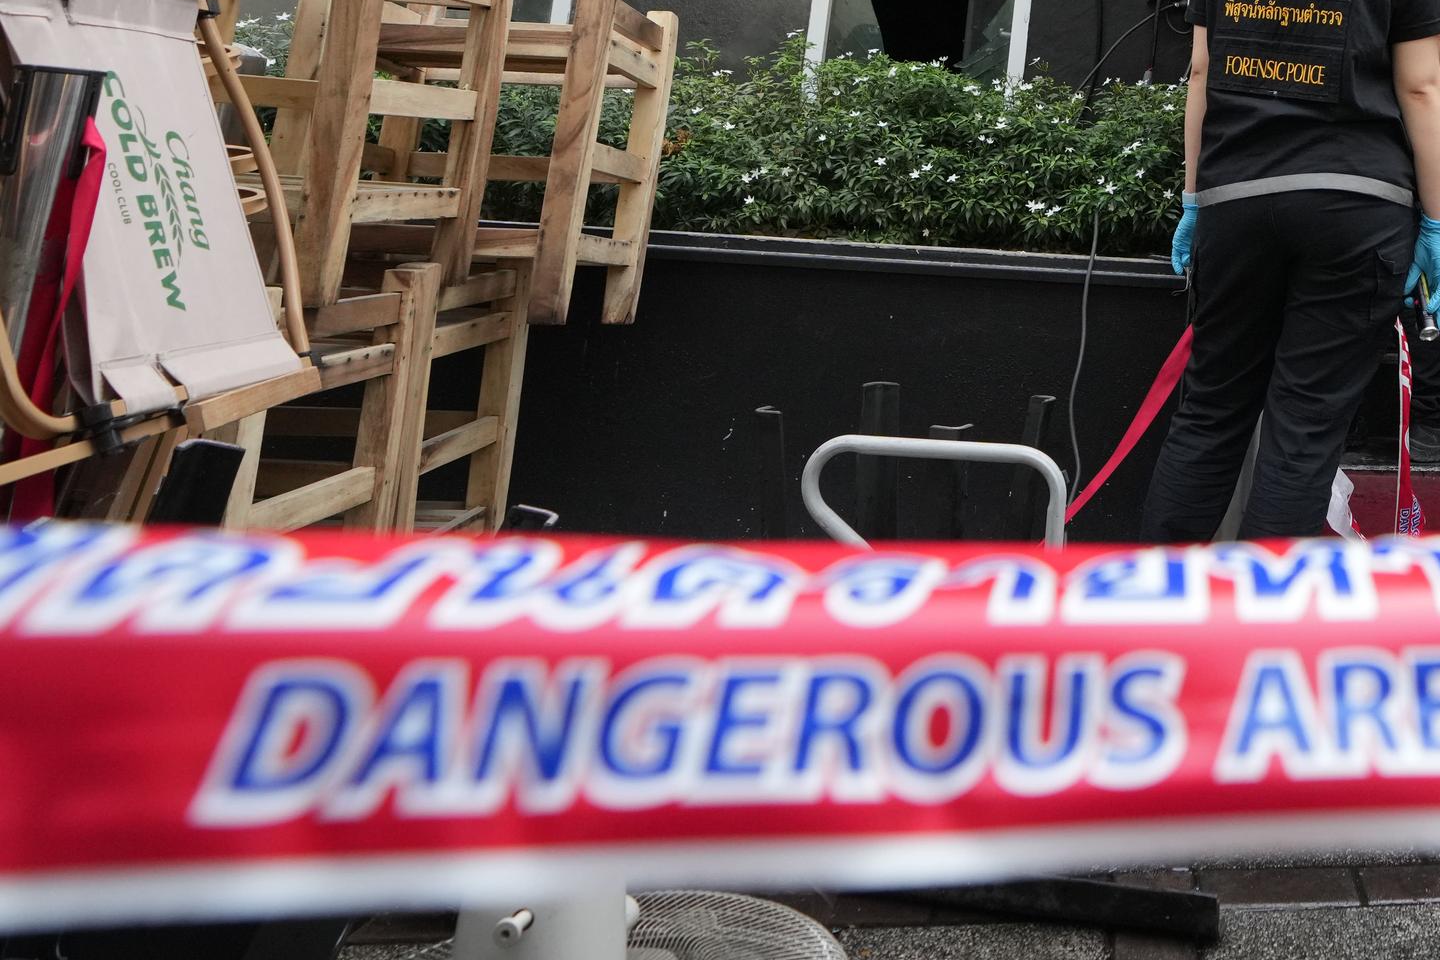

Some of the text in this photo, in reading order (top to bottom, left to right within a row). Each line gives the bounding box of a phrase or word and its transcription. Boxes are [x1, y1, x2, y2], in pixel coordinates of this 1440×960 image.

[1225, 55, 1326, 85] FORENSIC POLICE
[103, 70, 187, 312] COLD BREW
[107, 162, 132, 225] COOL CLUB
[165, 130, 210, 251] Chang
[191, 652, 1187, 827] DANGEROUS
